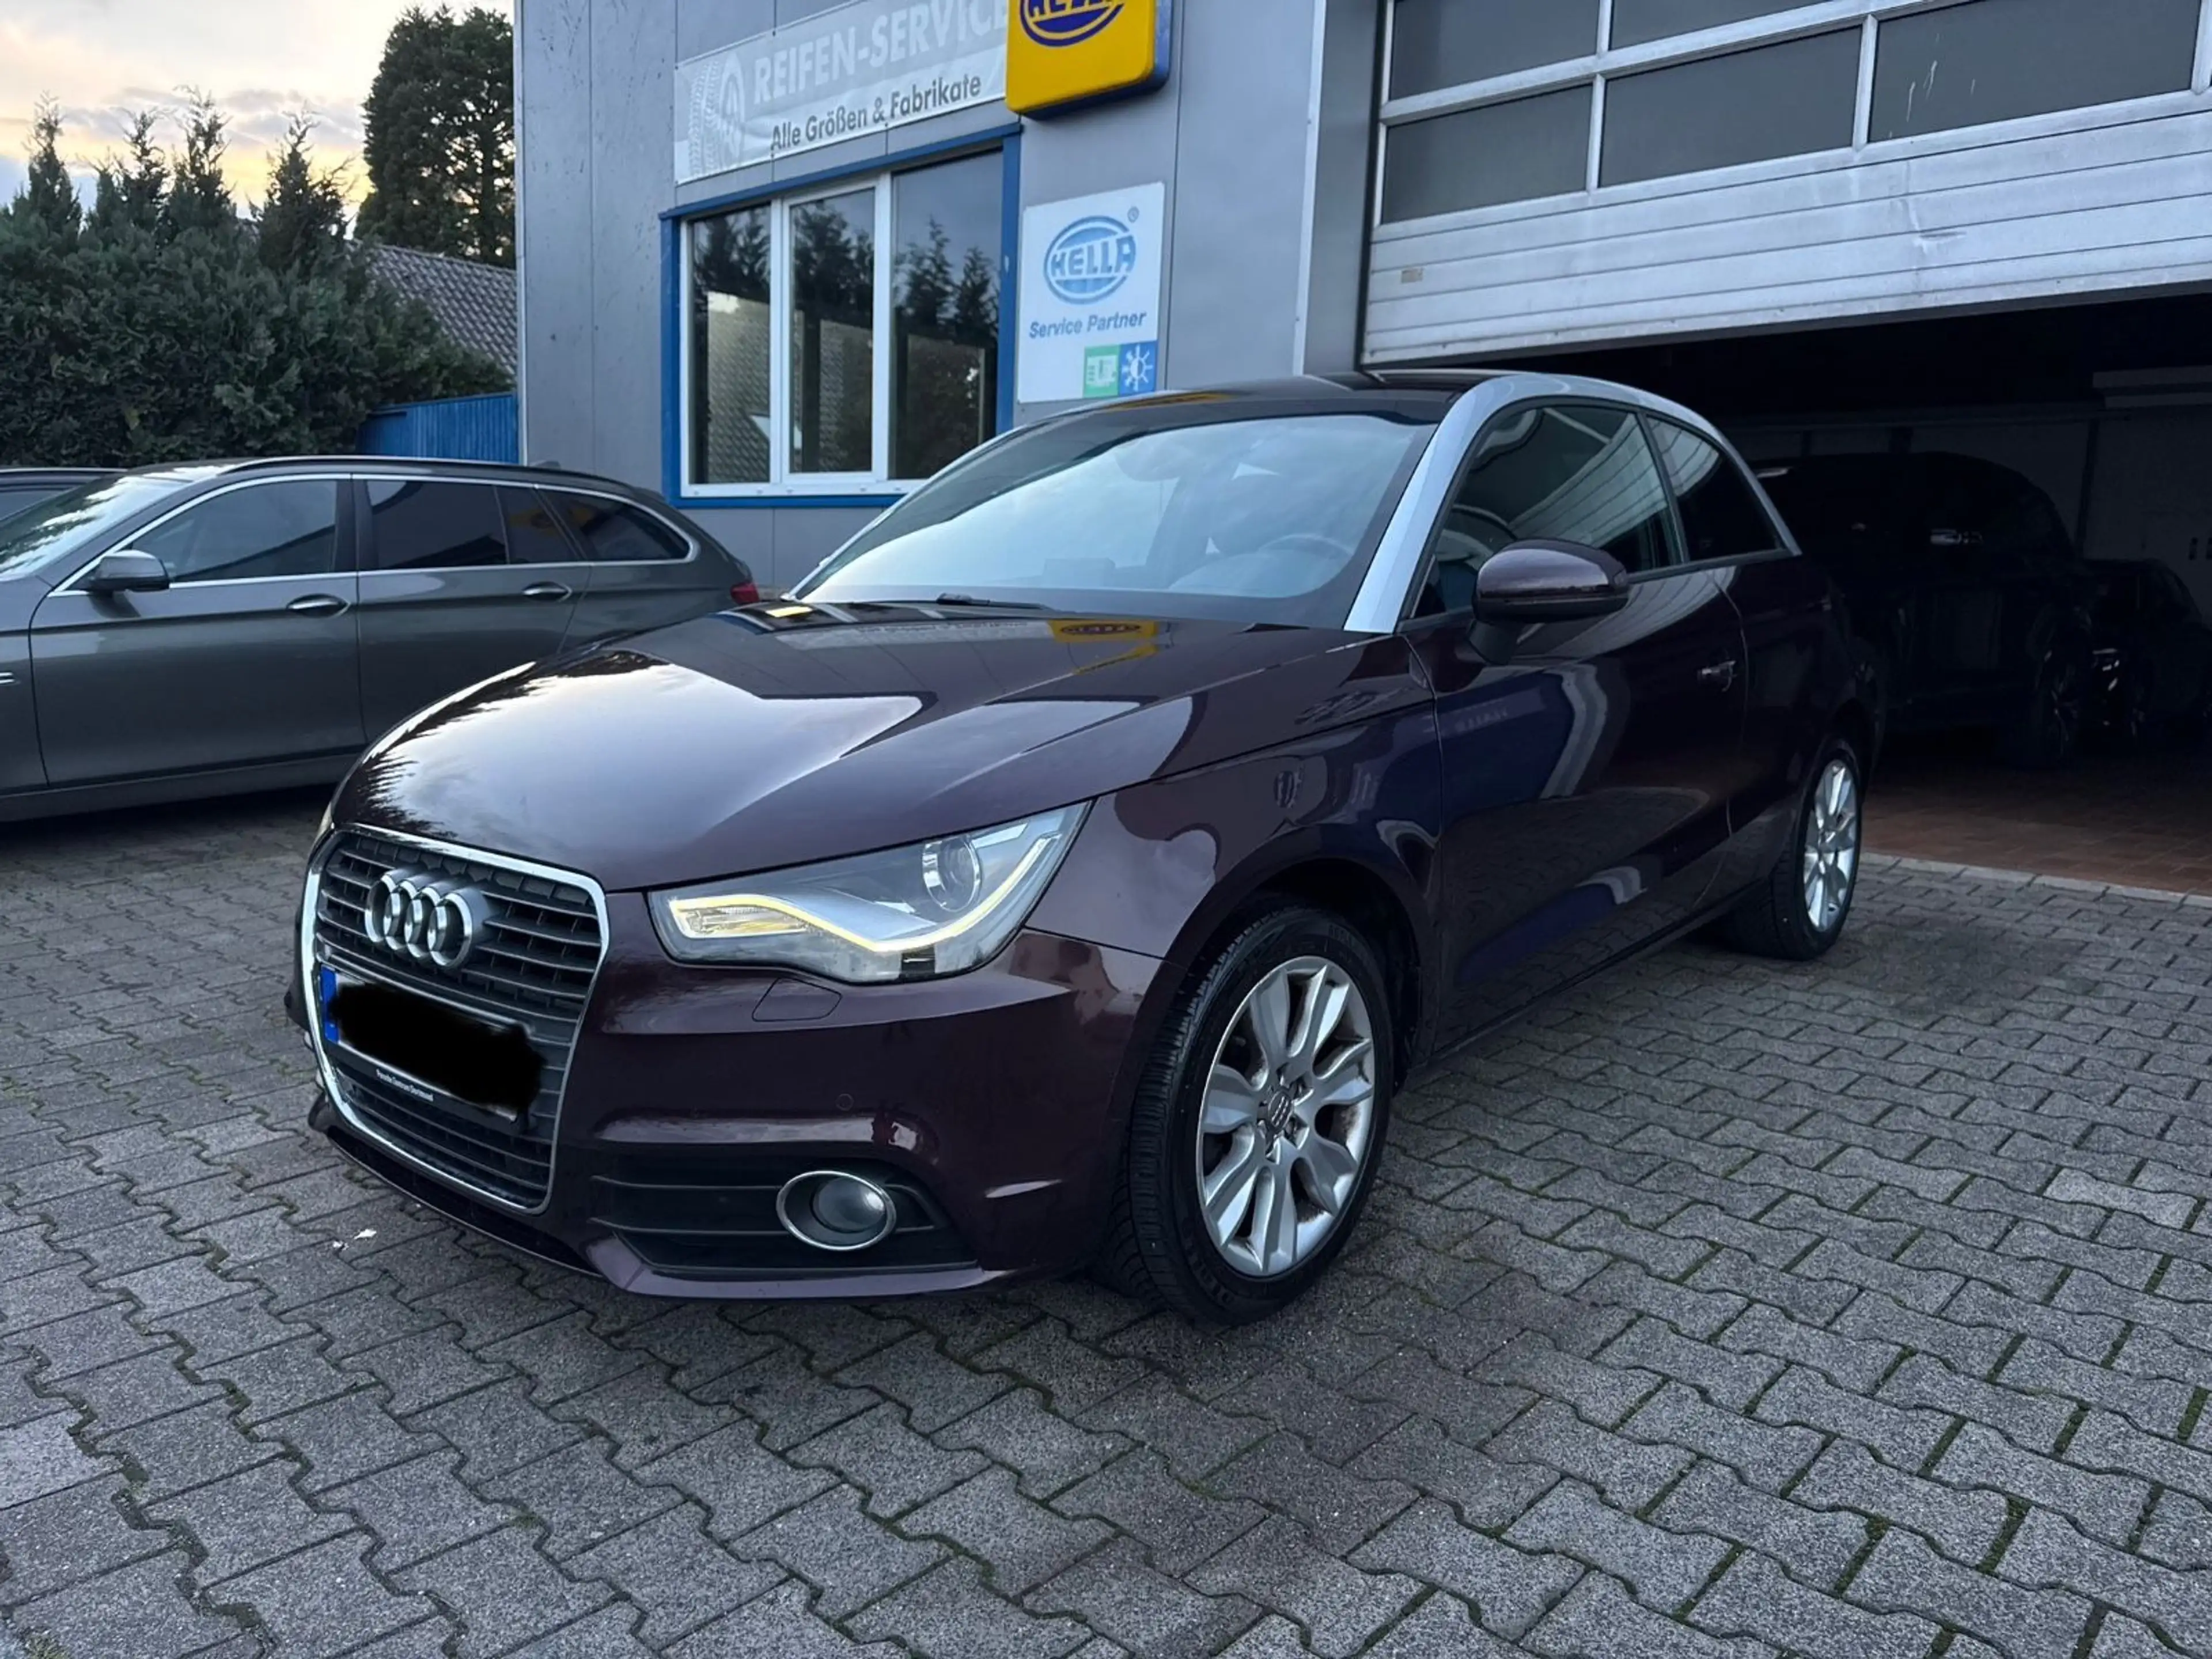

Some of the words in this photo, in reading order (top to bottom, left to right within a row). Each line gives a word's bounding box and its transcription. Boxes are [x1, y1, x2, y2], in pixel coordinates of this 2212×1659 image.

[770, 121, 801, 150] Alle
[805, 105, 868, 142] Größen
[872, 96, 885, 124] &
[890, 74, 981, 119] Fabrikate
[1051, 234, 1136, 277] HELLA
[1029, 317, 1082, 339] Service
[1086, 311, 1147, 332] Partner
